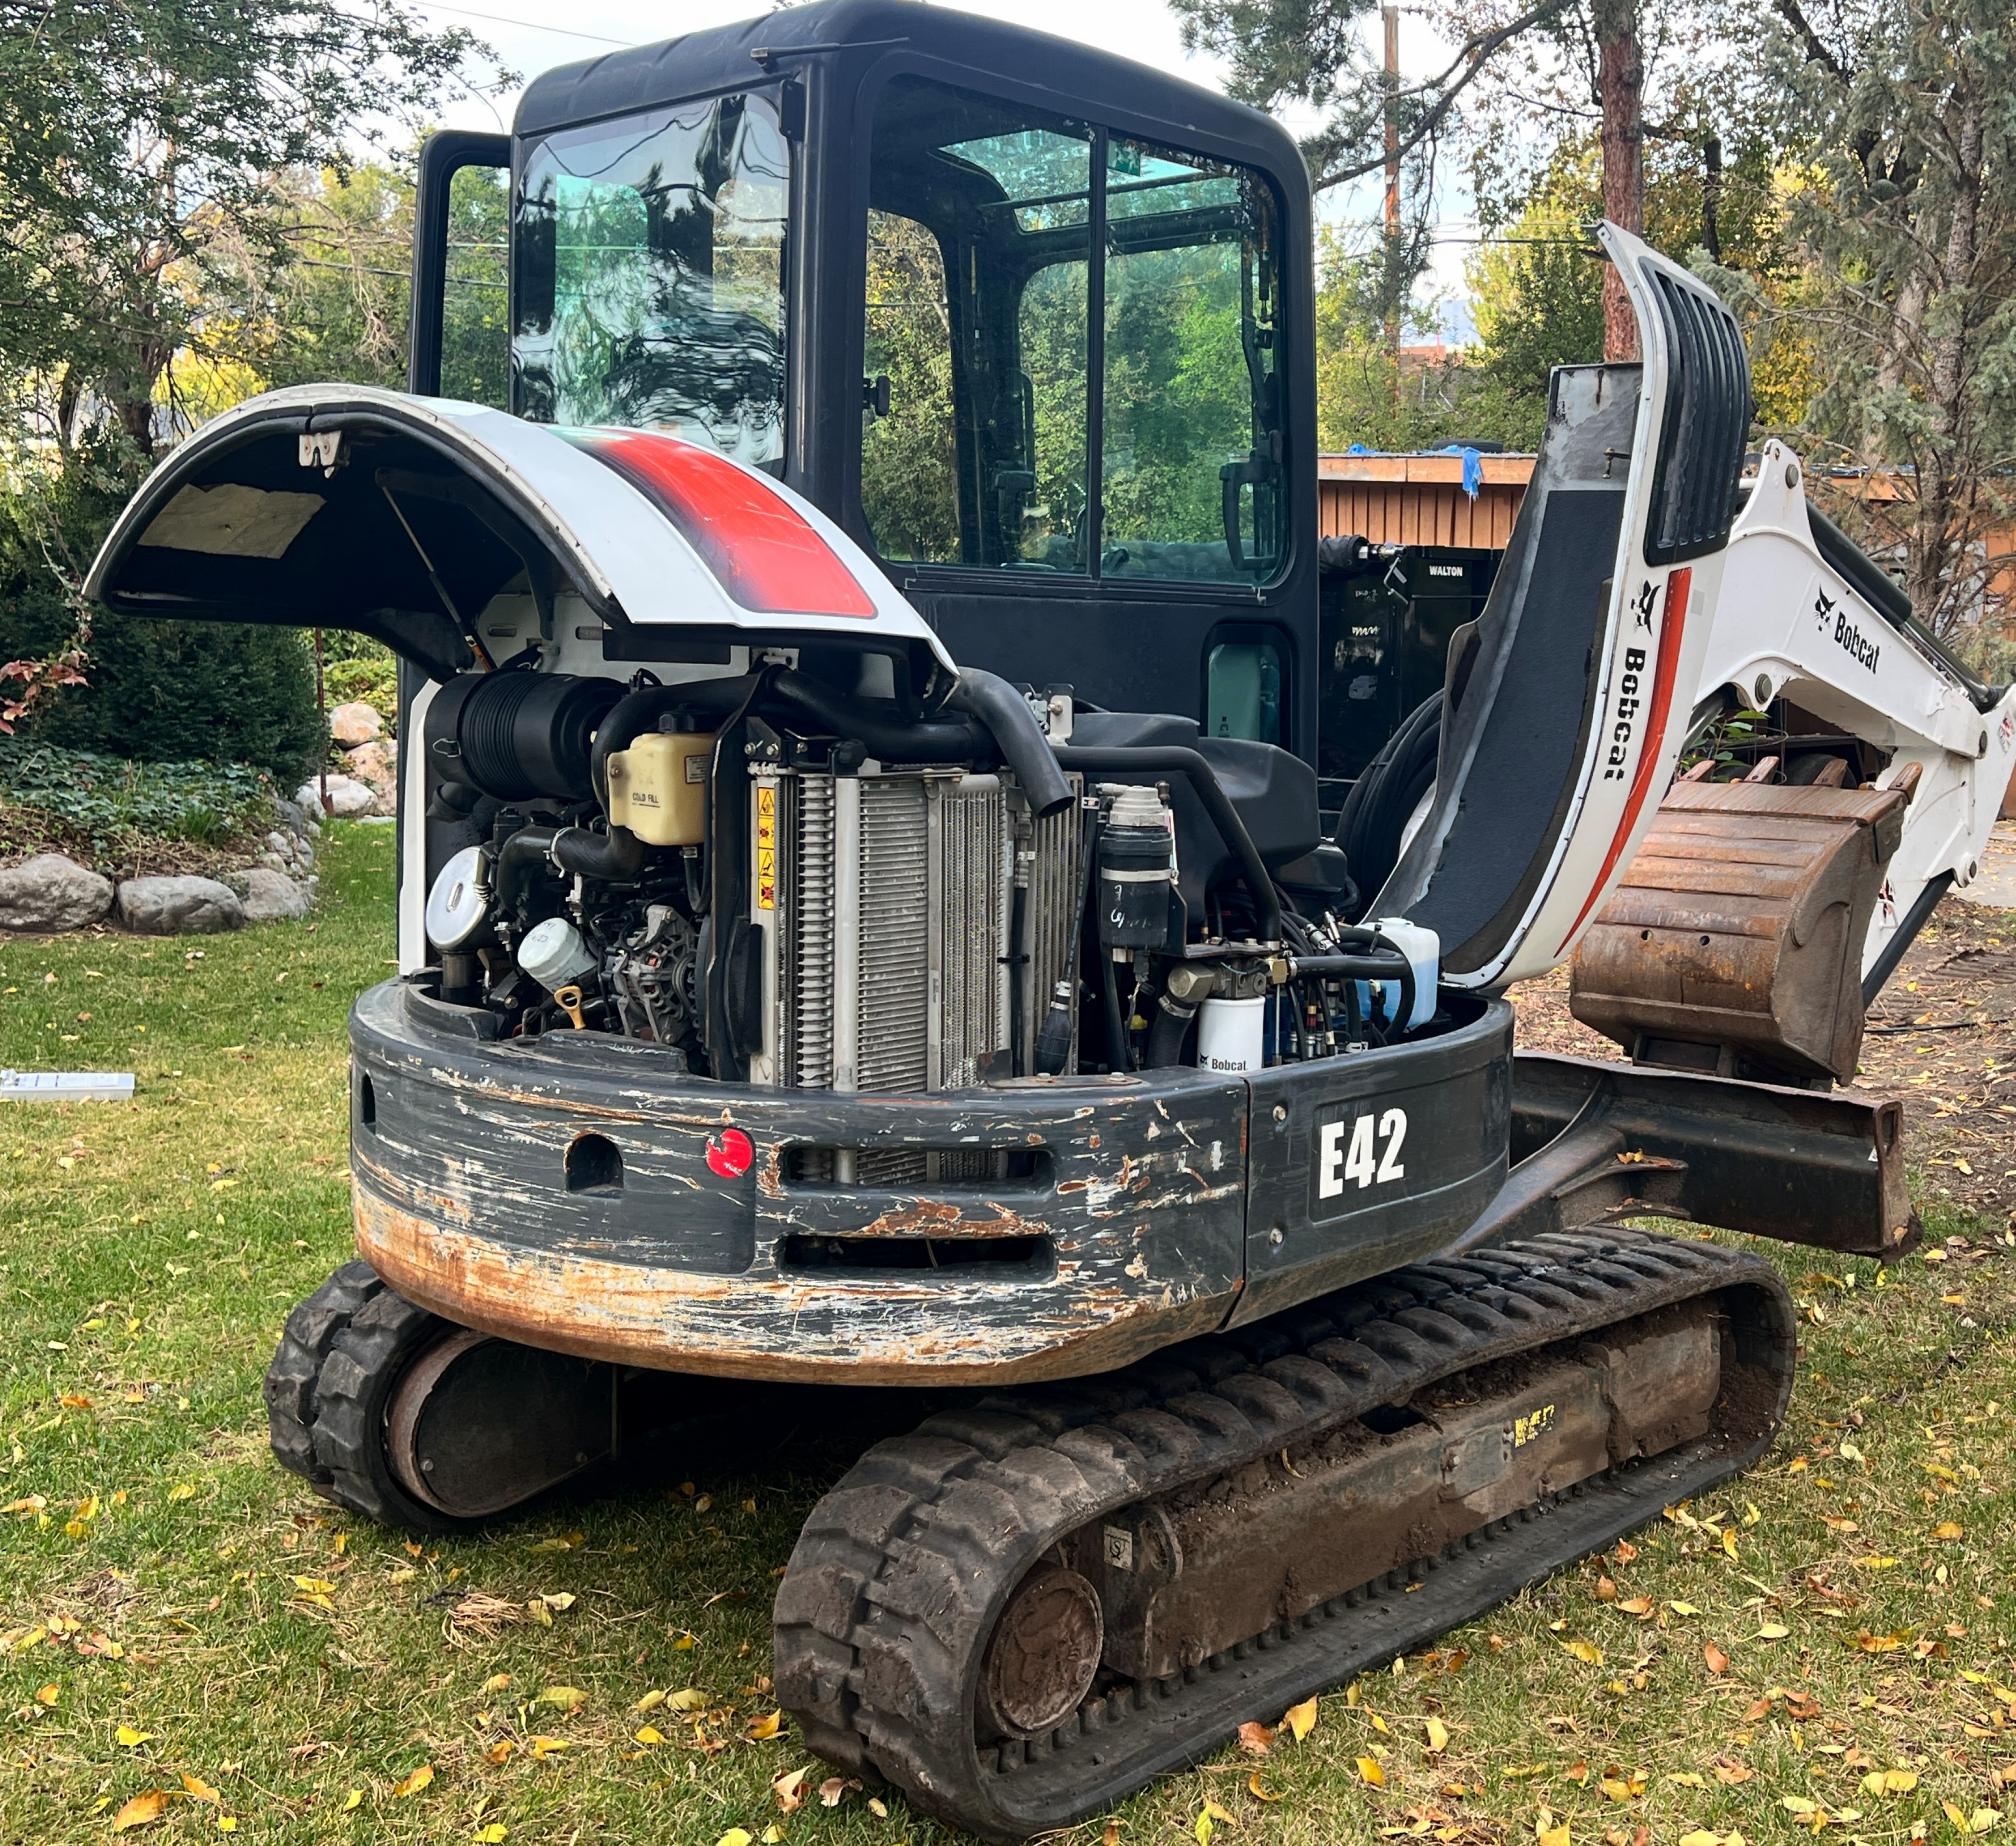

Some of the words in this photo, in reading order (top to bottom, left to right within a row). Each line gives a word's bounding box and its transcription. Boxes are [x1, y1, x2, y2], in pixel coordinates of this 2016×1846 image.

[1429, 565, 1463, 577] WALTON
[1834, 611, 1880, 675] Bobcat
[1604, 647, 1647, 781] Bobcat
[1211, 1058, 1247, 1072] Bobcat
[1319, 1107, 1408, 1200] E42
